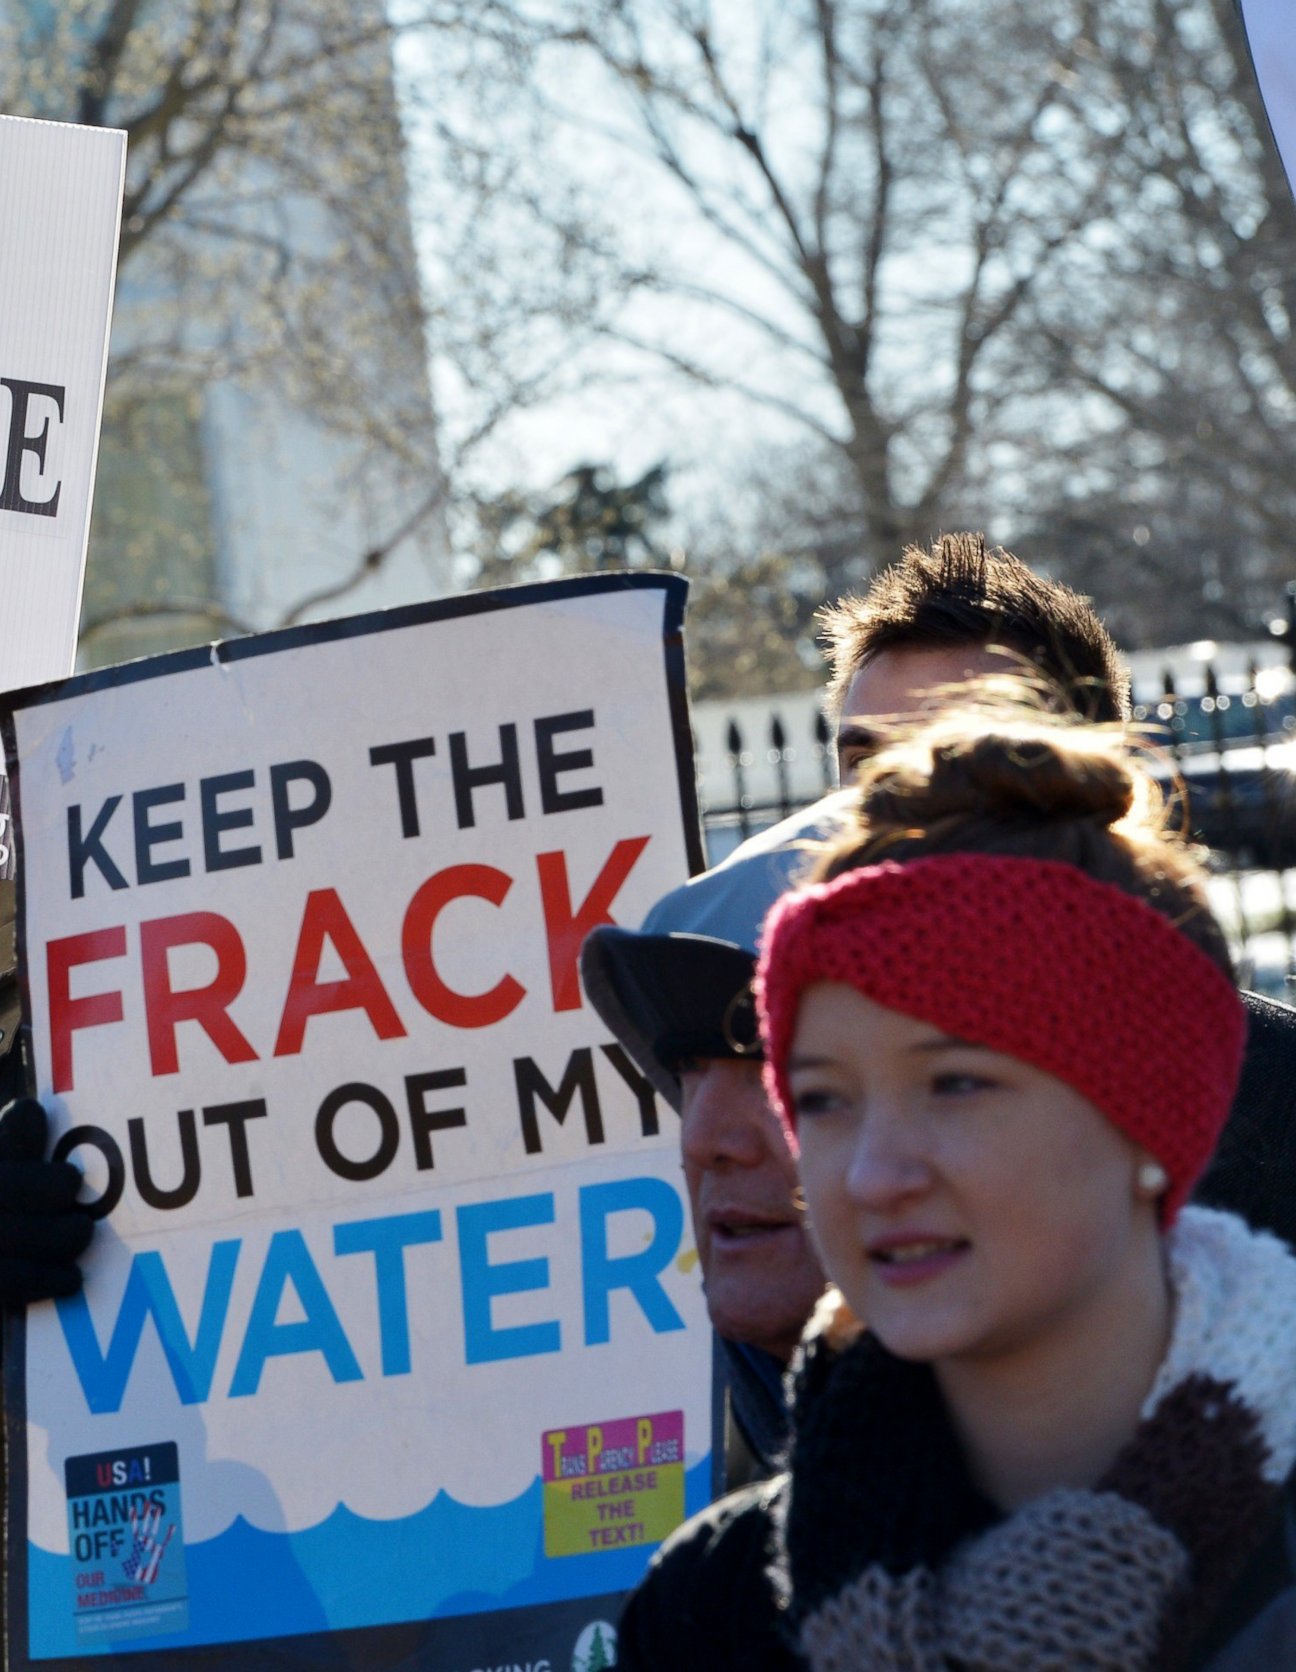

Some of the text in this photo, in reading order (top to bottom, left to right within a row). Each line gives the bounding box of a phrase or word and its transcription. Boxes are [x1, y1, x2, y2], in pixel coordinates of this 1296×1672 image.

[66, 709, 604, 899] KEEP THE
[46, 835, 652, 1095] FRACK
[51, 1043, 662, 1221] OUT OF MY
[52, 1176, 686, 1415] WATER
[96, 1457, 151, 1488] USA!
[571, 1472, 657, 1500] RELEASE
[72, 1489, 166, 1530] HANDS
[597, 1501, 635, 1521] THE
[75, 1529, 125, 1562] OFF
[589, 1523, 644, 1547] TEXT!
[76, 1570, 104, 1588] OUR
